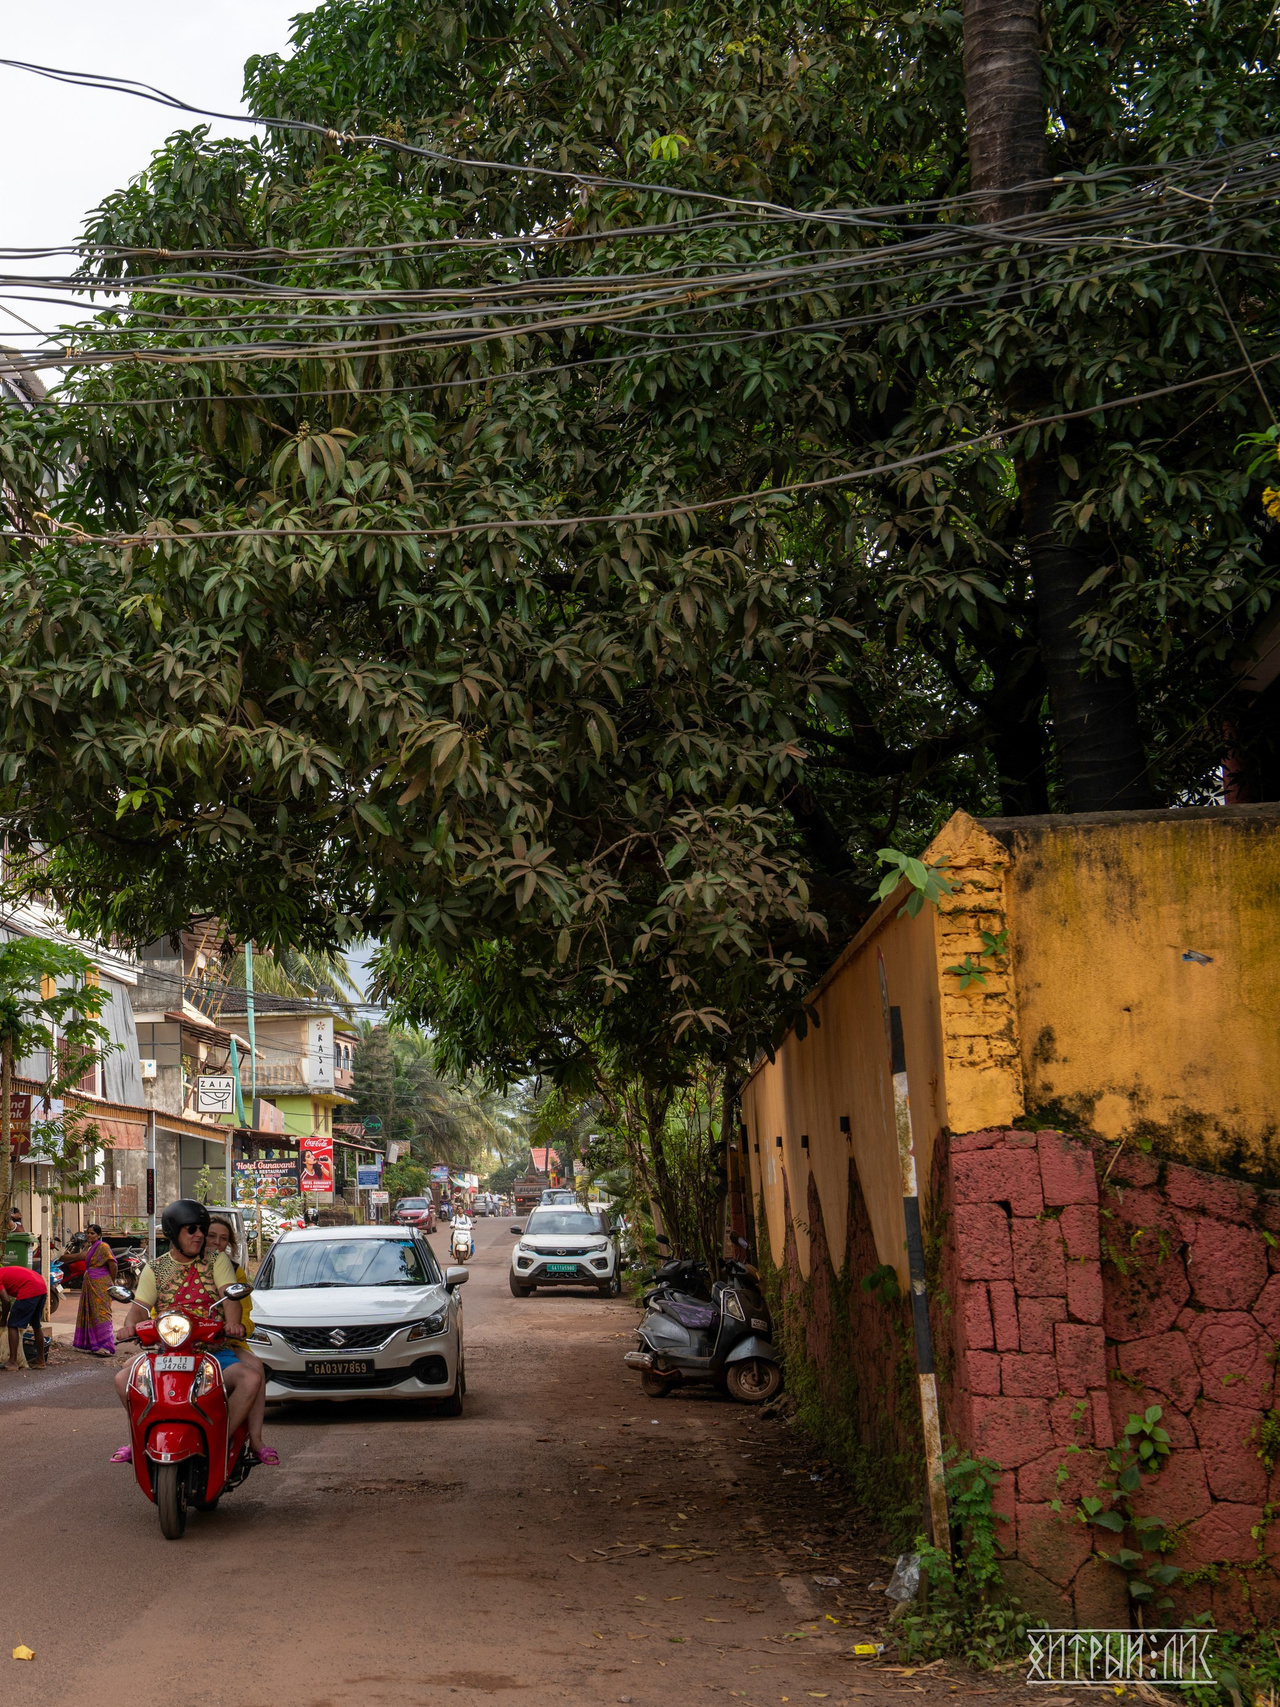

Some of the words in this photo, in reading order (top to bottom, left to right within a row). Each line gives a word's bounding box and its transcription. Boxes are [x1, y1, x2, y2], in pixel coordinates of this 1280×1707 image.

[236, 1162, 256, 1170] Hotel
[258, 1161, 296, 1169] Gunavanti
[314, 1362, 366, 1374] GA03V7859
